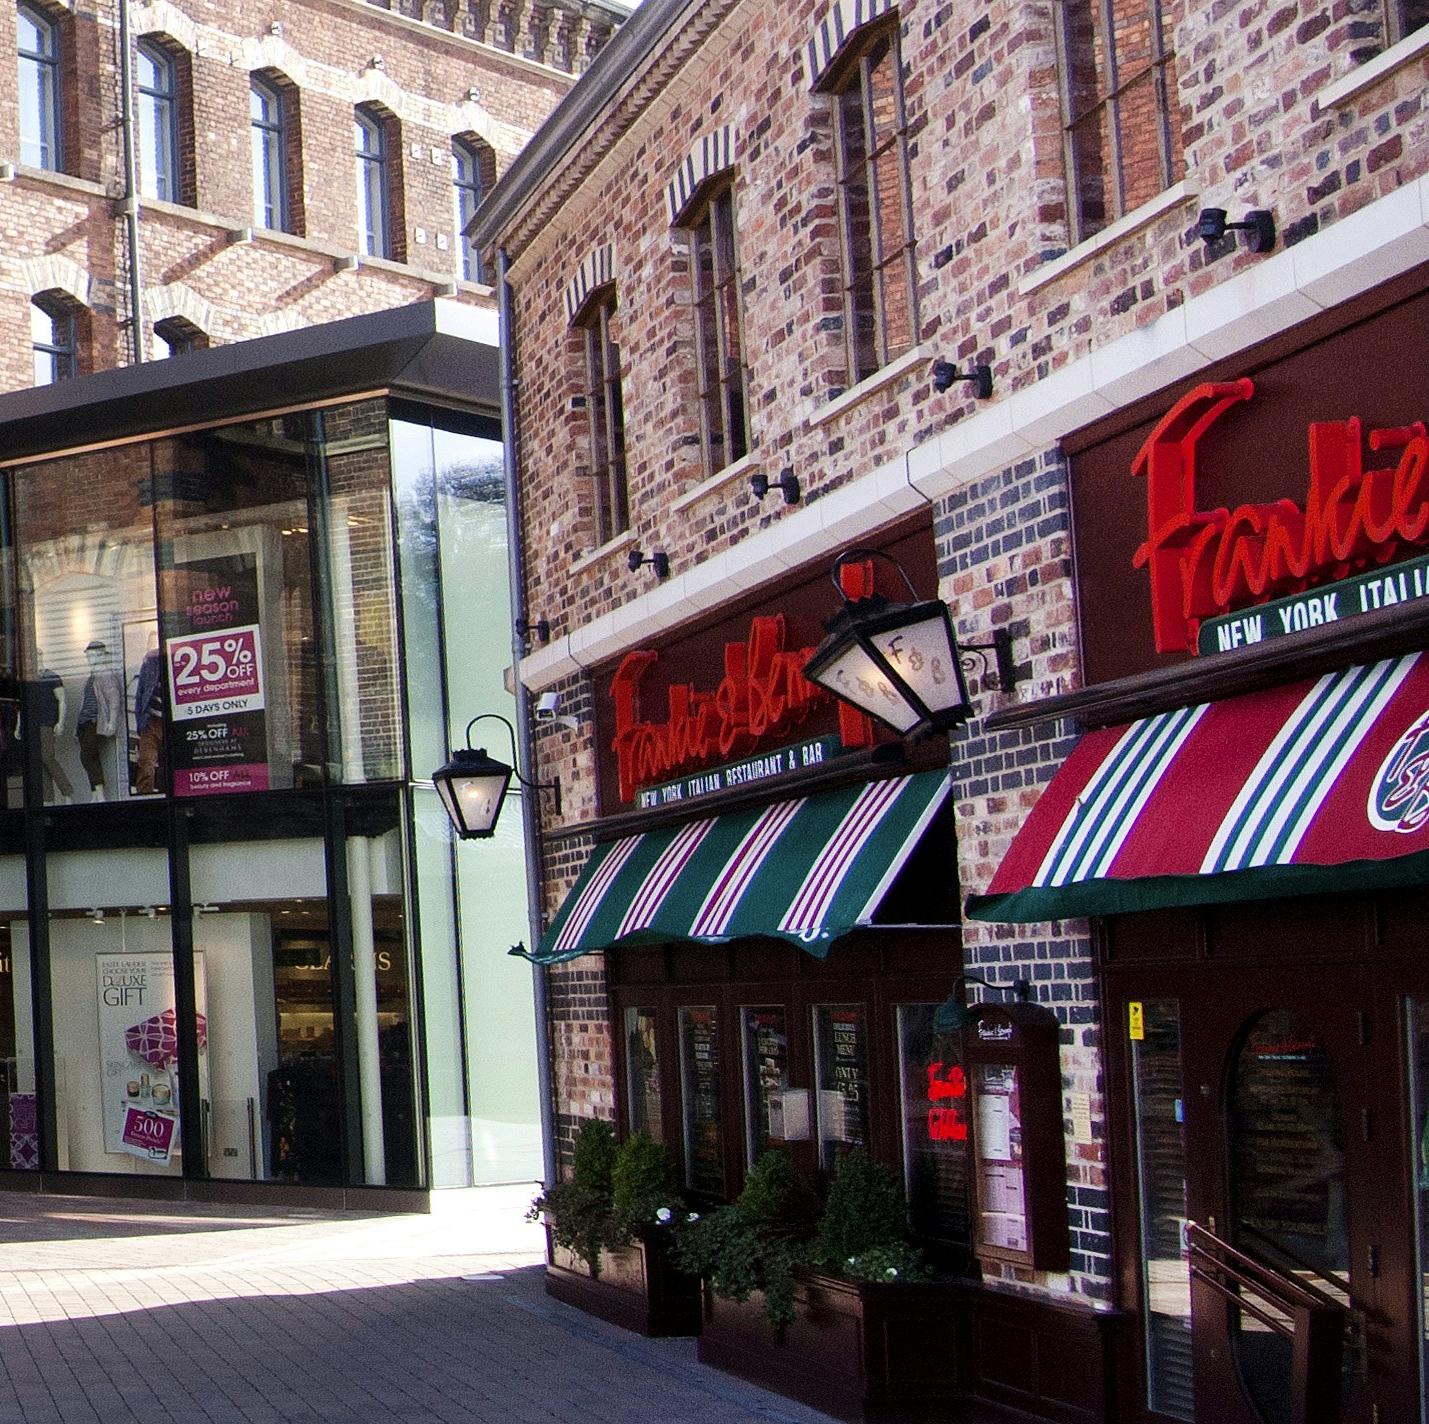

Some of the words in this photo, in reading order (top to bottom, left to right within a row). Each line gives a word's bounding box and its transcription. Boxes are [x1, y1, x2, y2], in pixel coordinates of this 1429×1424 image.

[1131, 377, 1429, 656] Frankie
[192, 586, 231, 602] new
[185, 600, 239, 616] season
[1216, 613, 1262, 653] NEW
[1279, 591, 1339, 633] YORK
[1359, 564, 1429, 613] ITALI
[193, 614, 233, 625] launch
[174, 638, 252, 685] 25%
[227, 663, 254, 678] OFF
[178, 686, 201, 696] every
[203, 678, 254, 693] department
[195, 702, 220, 713] DAYS
[222, 699, 248, 710] ONLY
[186, 730, 208, 741] 25%
[208, 728, 228, 738] OFF
[610, 650, 717, 803] Frankie
[189, 771, 209, 783] 10%
[210, 770, 230, 780] OFF
[640, 790, 658, 808] NEW
[662, 786, 682, 803] YORK
[688, 774, 720, 797] ITALIAN
[725, 754, 782, 786] RESTAURANT
[802, 742, 823, 766] BAR
[103, 988, 147, 1006] GIFT
[134, 1115, 164, 1138] 500
